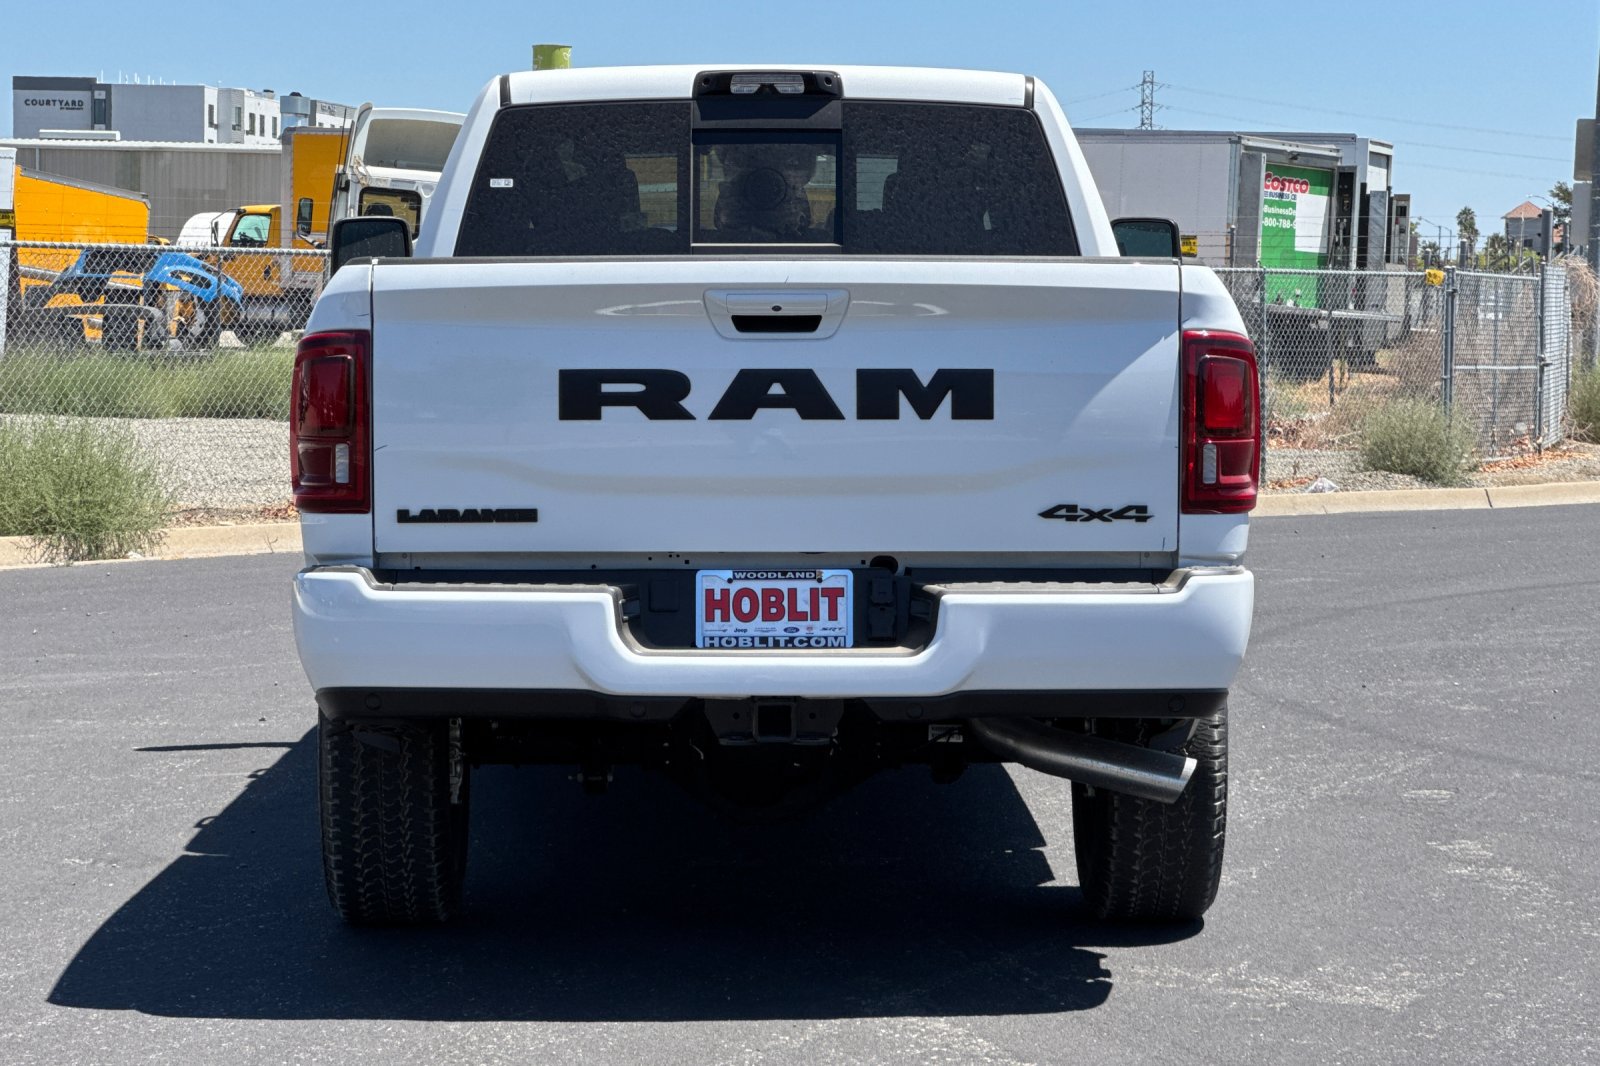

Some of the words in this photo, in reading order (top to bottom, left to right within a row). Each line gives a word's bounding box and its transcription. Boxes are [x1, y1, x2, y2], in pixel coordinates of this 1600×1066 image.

[24, 98, 84, 107] COURTYARD
[1264, 172, 1309, 194] COSTCO
[1269, 191, 1290, 200] BUSINESS
[559, 368, 995, 420] RAM
[734, 571, 815, 579] WOODLAND
[704, 587, 845, 623] HOBLIT
[703, 636, 845, 648] HOBLIT.COM
